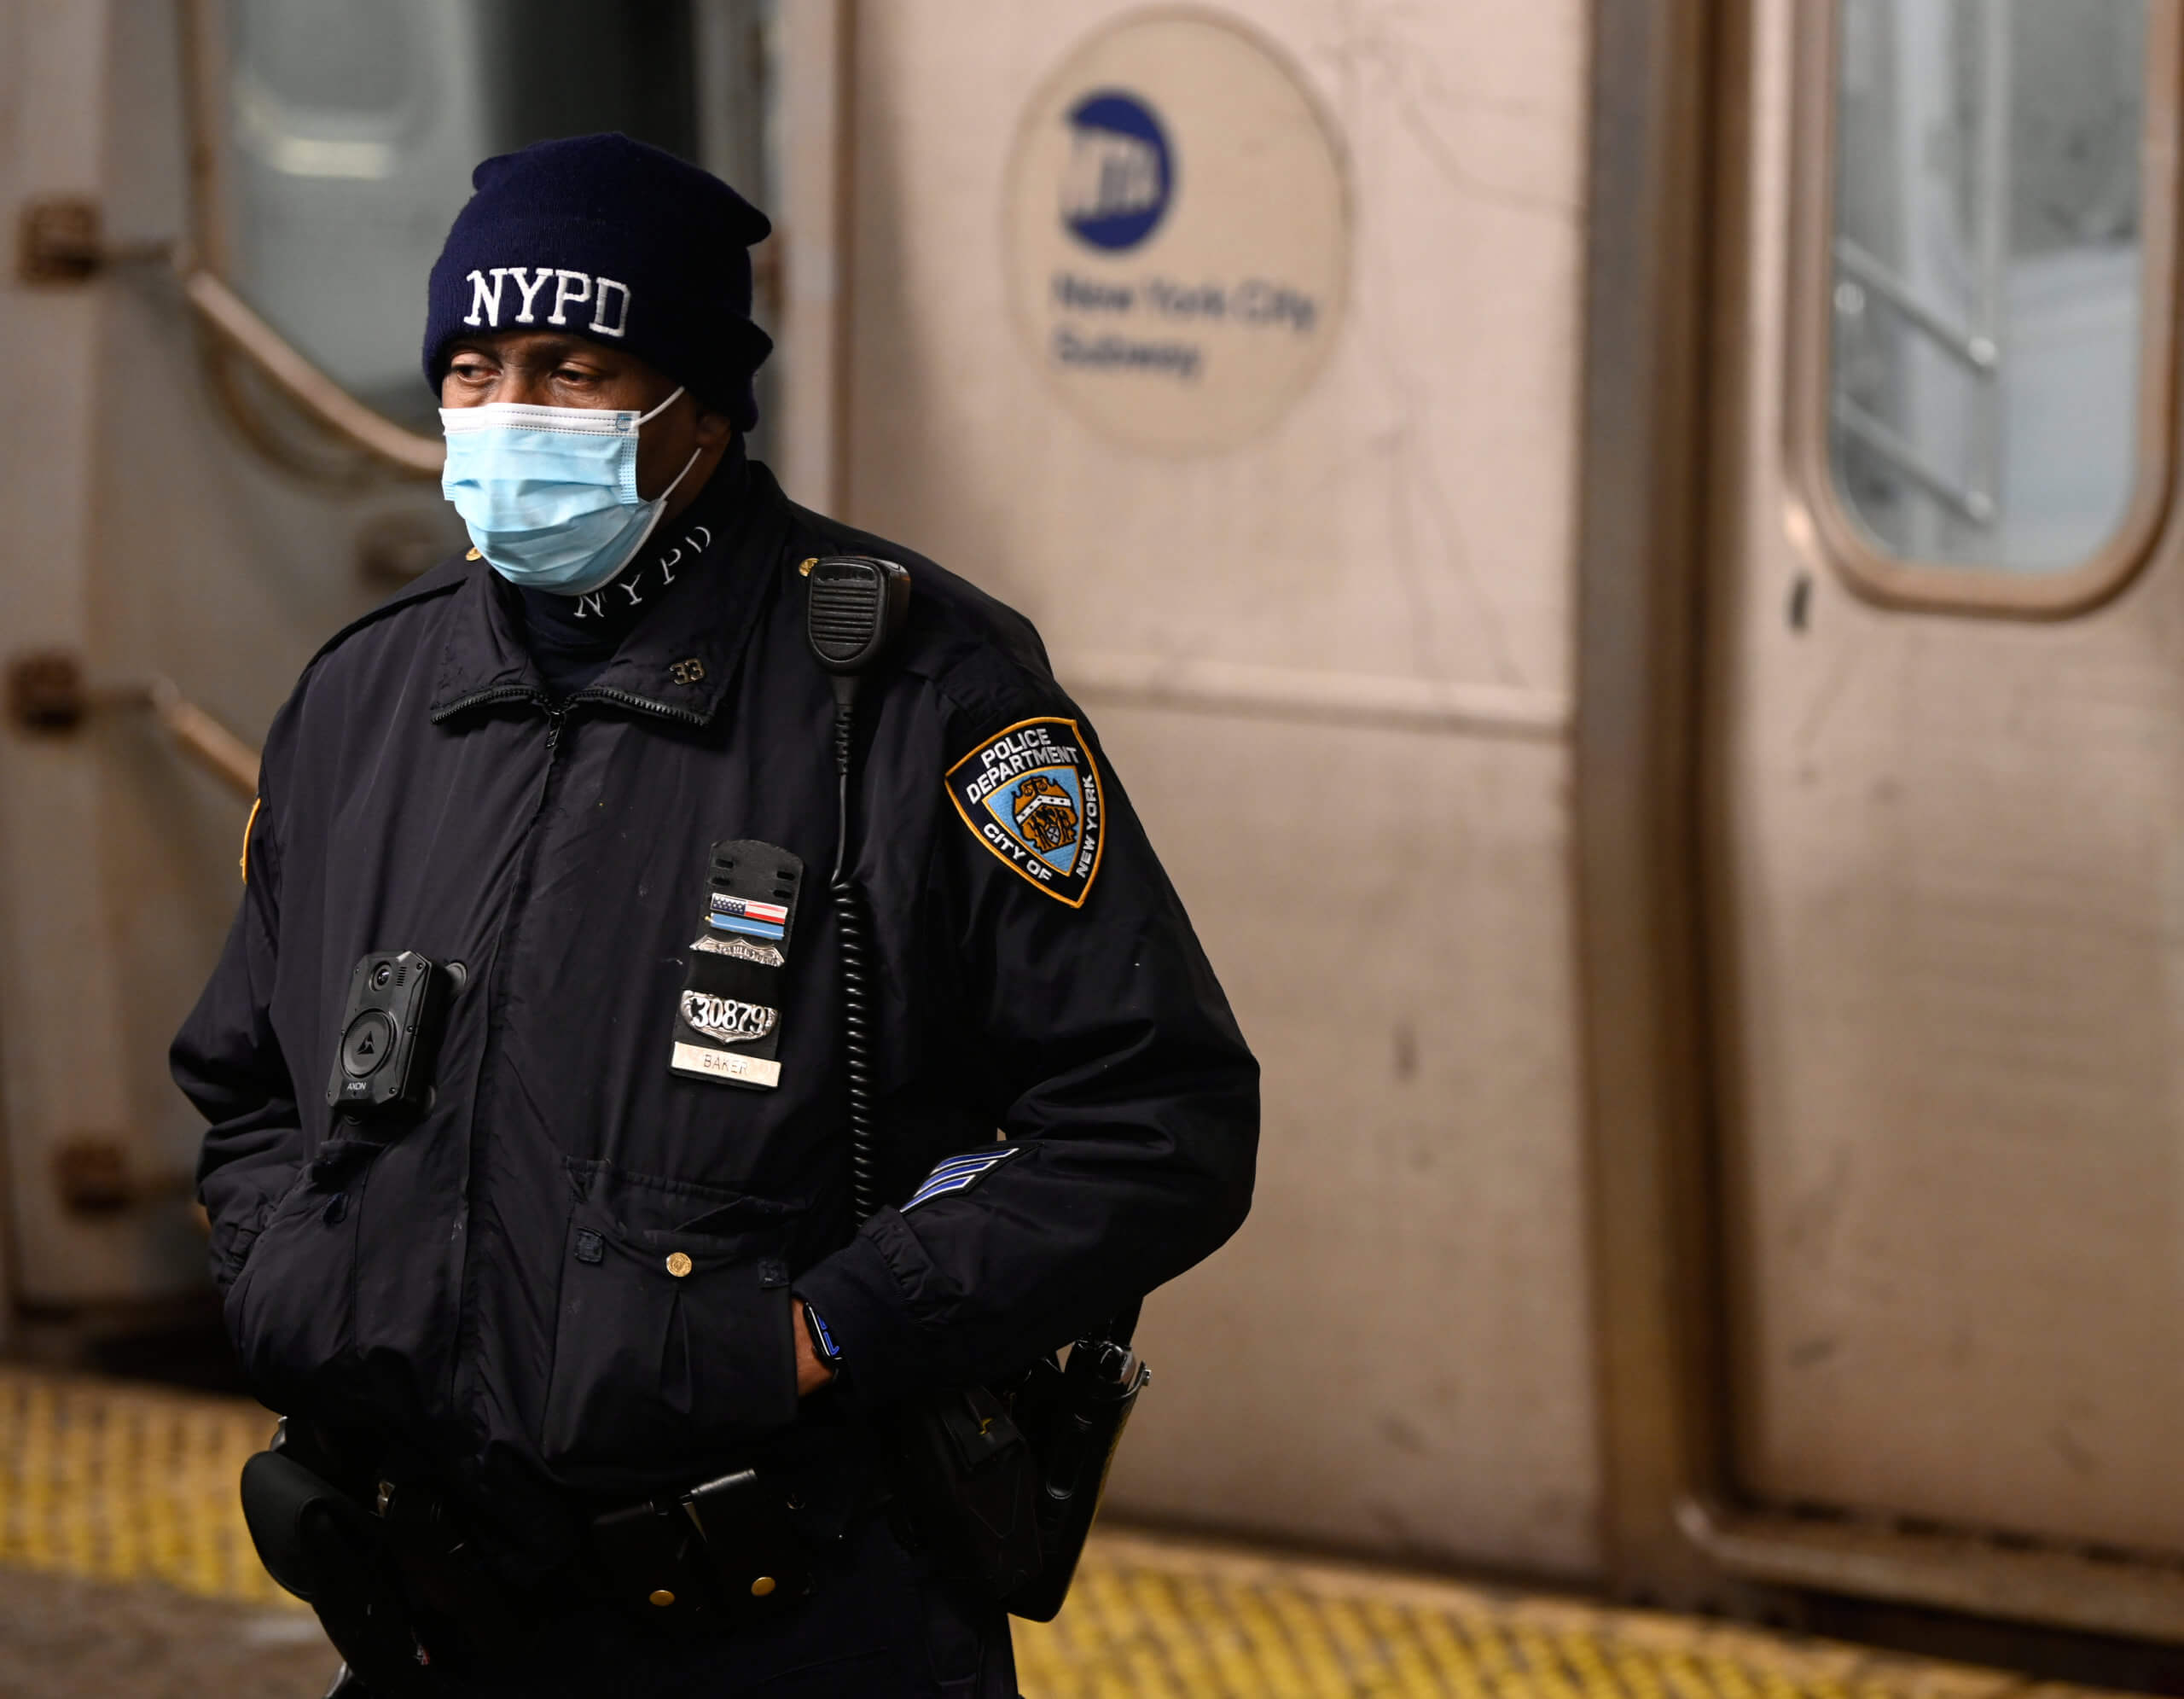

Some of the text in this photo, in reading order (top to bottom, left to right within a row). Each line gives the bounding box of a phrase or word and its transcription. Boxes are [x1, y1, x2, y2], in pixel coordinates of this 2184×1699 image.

[463, 266, 631, 338] NYPD
[1051, 274, 1316, 331] New York City
[1053, 326, 1200, 379] Subway
[573, 526, 712, 618] NYPD
[670, 658, 706, 685] 33
[966, 746, 1079, 805] DEPARTMENT
[980, 728, 1051, 769] POLICE
[983, 823, 1053, 881] CITY OF
[1076, 774, 1098, 878] NEW YORK
[692, 997, 766, 1034] 30879
[346, 1081, 367, 1091] AXON
[703, 1054, 749, 1075] BAKER
